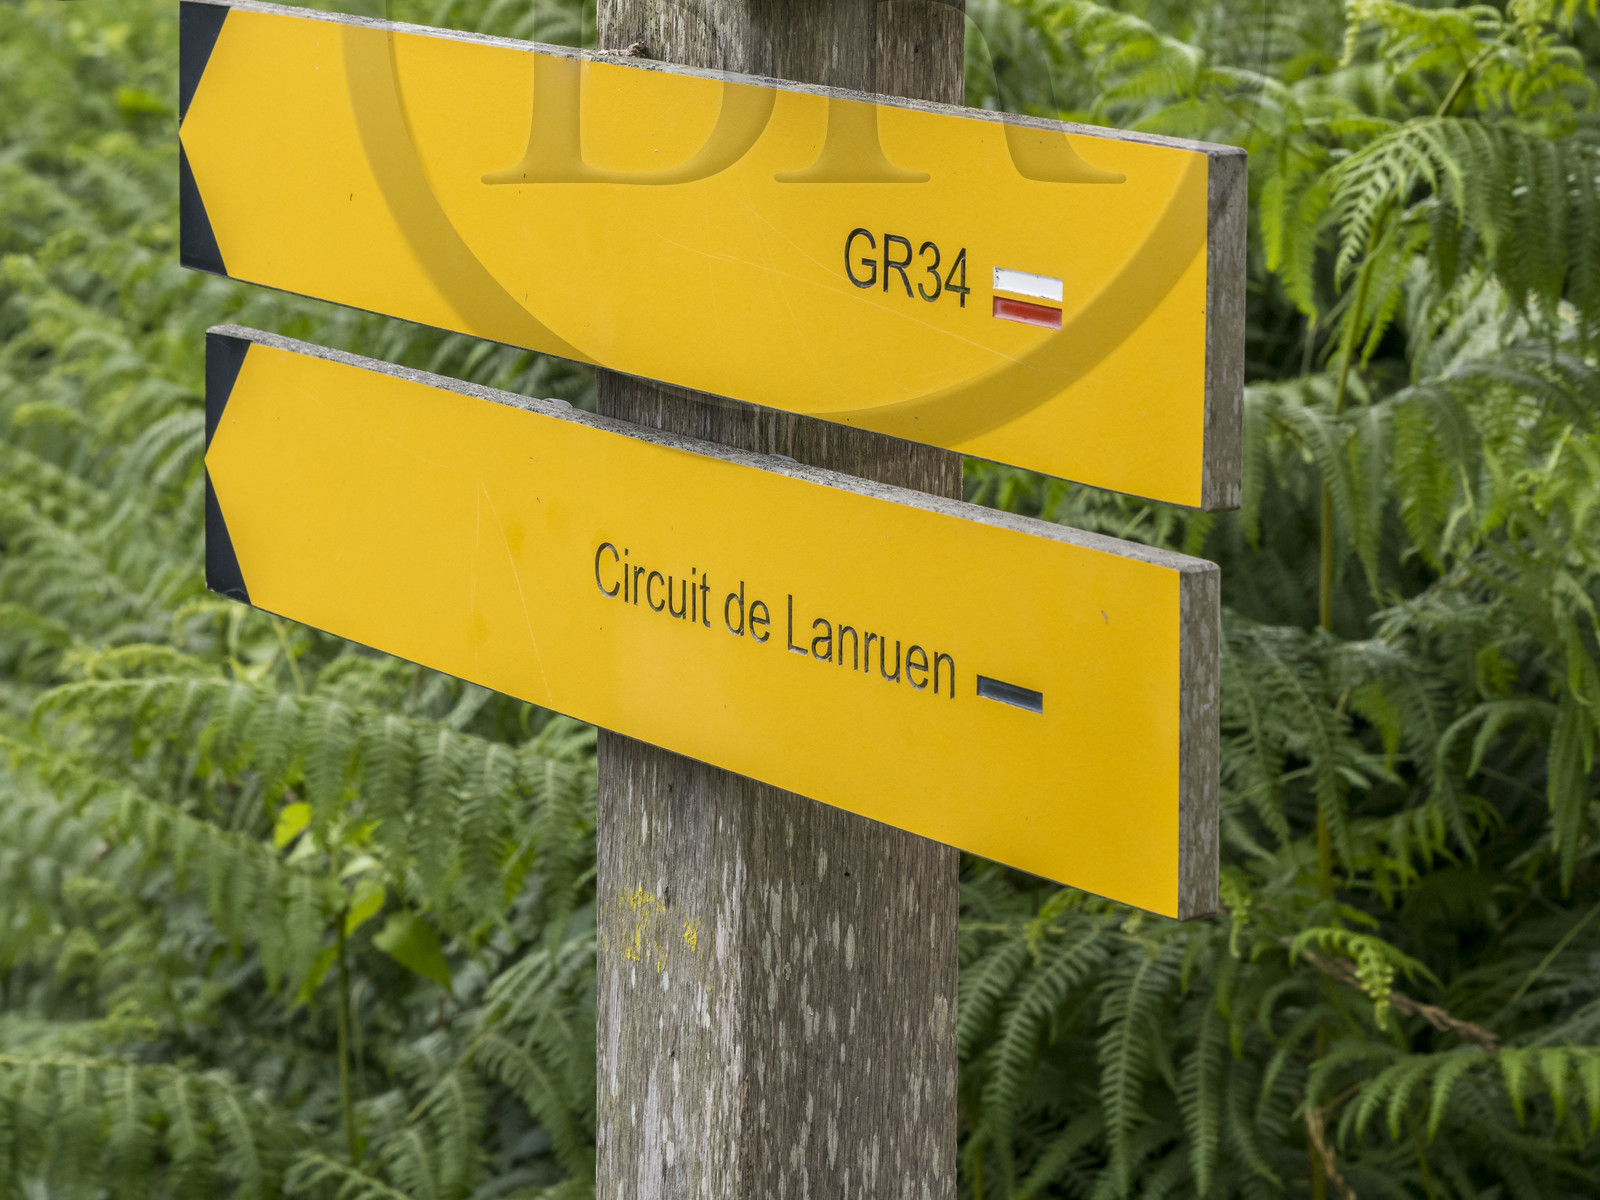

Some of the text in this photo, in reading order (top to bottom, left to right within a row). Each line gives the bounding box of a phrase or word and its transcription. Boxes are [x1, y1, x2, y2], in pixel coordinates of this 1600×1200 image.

[844, 227, 971, 308] GR34
[594, 542, 955, 700] Circuit de Lanruen
